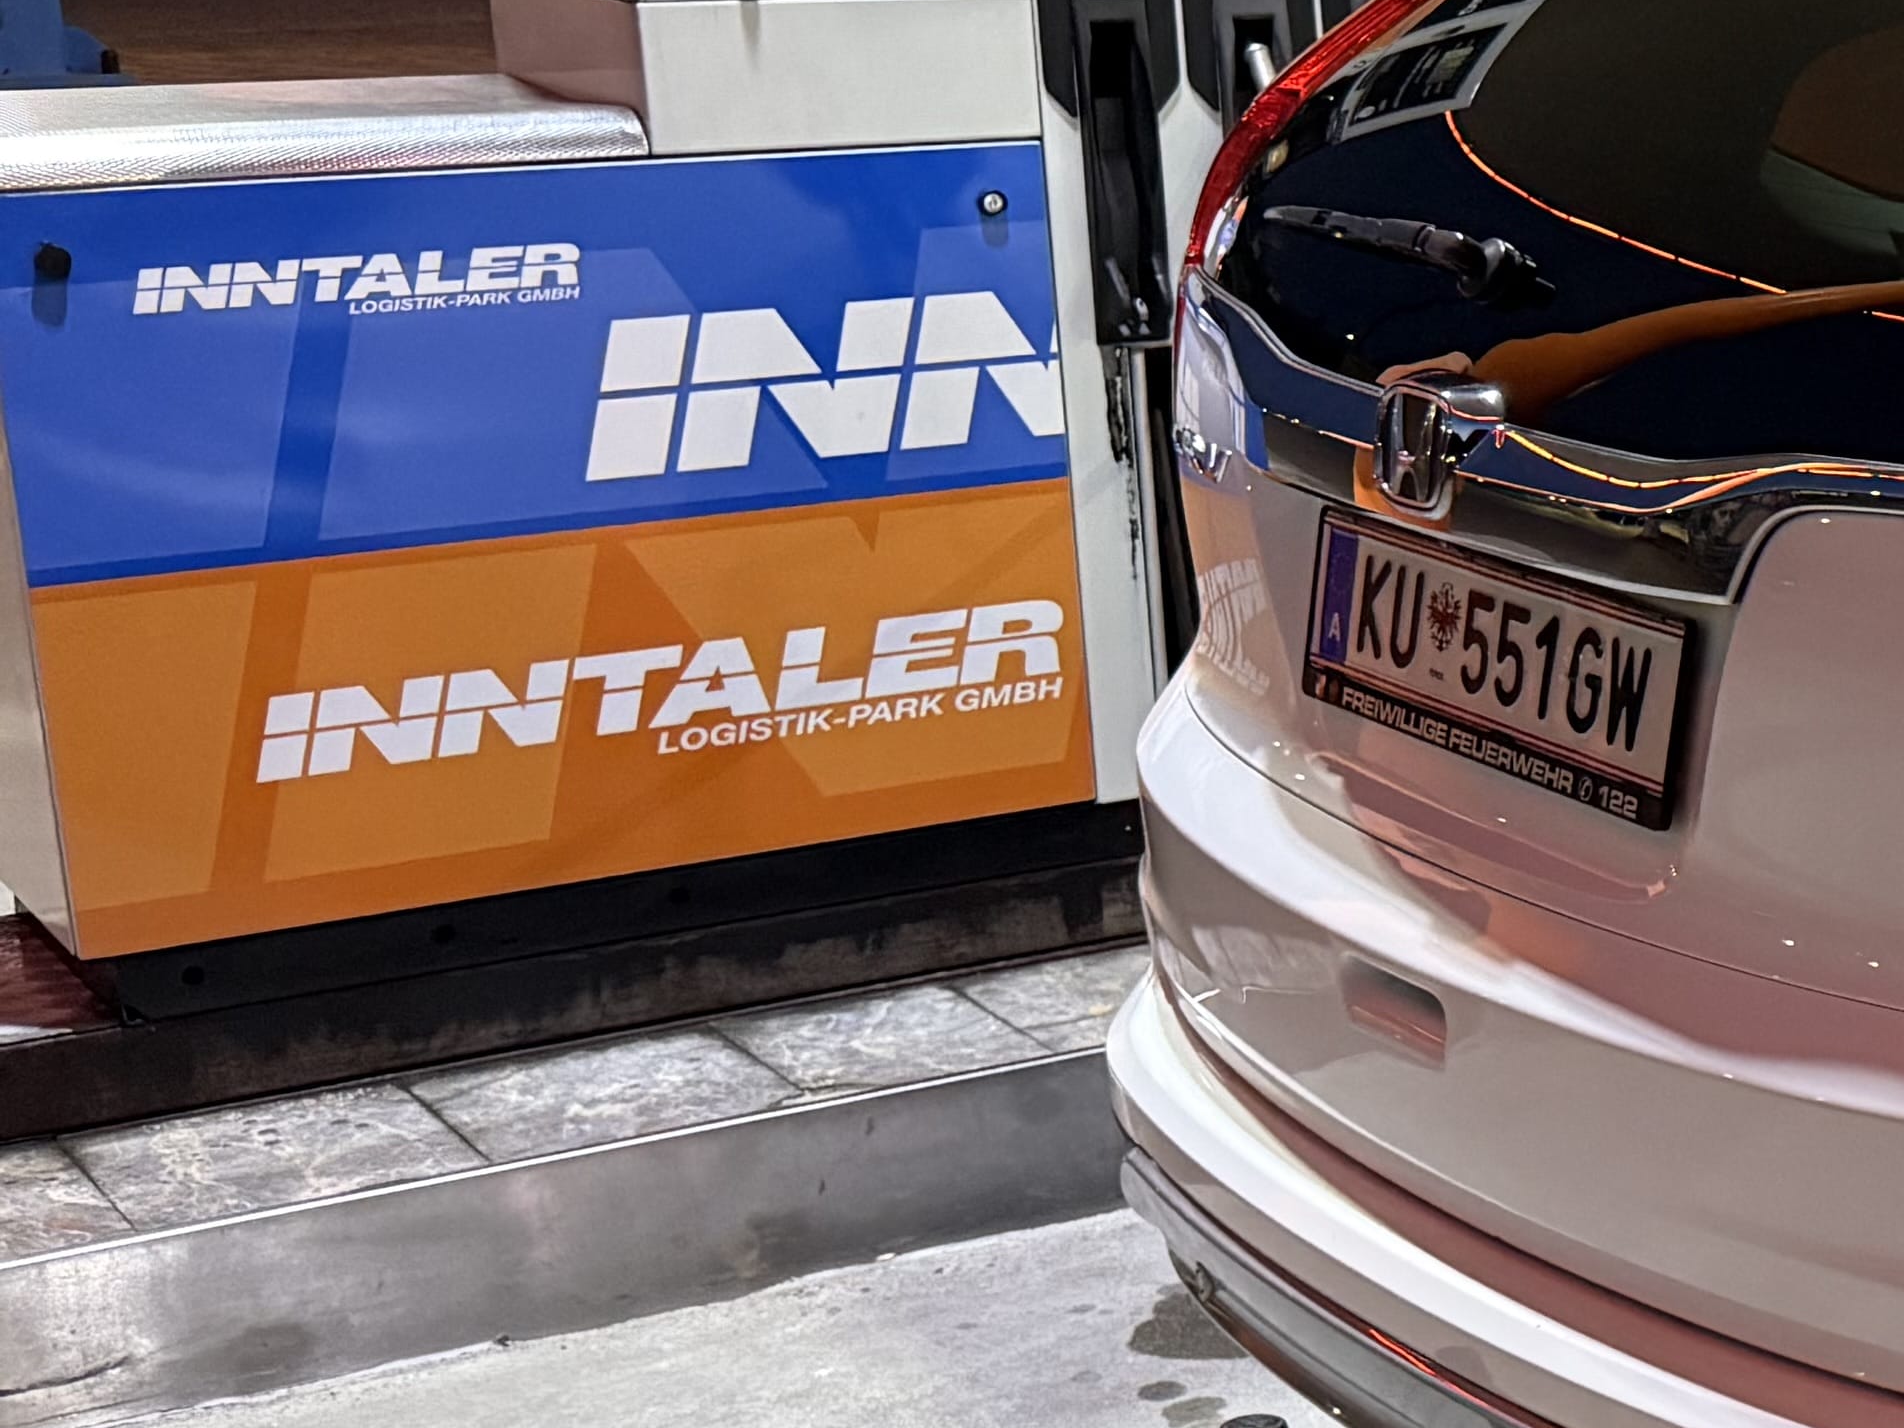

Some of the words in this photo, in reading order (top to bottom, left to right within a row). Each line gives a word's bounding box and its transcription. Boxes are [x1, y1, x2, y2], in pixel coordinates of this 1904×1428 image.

[132, 242, 581, 315] INNTALER
[348, 291, 514, 315] LOGISTIK-PARK
[517, 285, 581, 305] GMBH
[586, 291, 1066, 482] INN
[1328, 612, 1342, 641] A
[1356, 554, 1426, 669] KU
[1459, 587, 1653, 753] 551GW
[256, 599, 1065, 783] INNTALER
[657, 691, 942, 755] LOGISTIK-PARK
[955, 677, 1063, 714] GMBH
[1341, 686, 1447, 745] FREIWILLIGE
[1448, 728, 1575, 794] FEUERWEHR
[1599, 777, 1640, 820] 122
